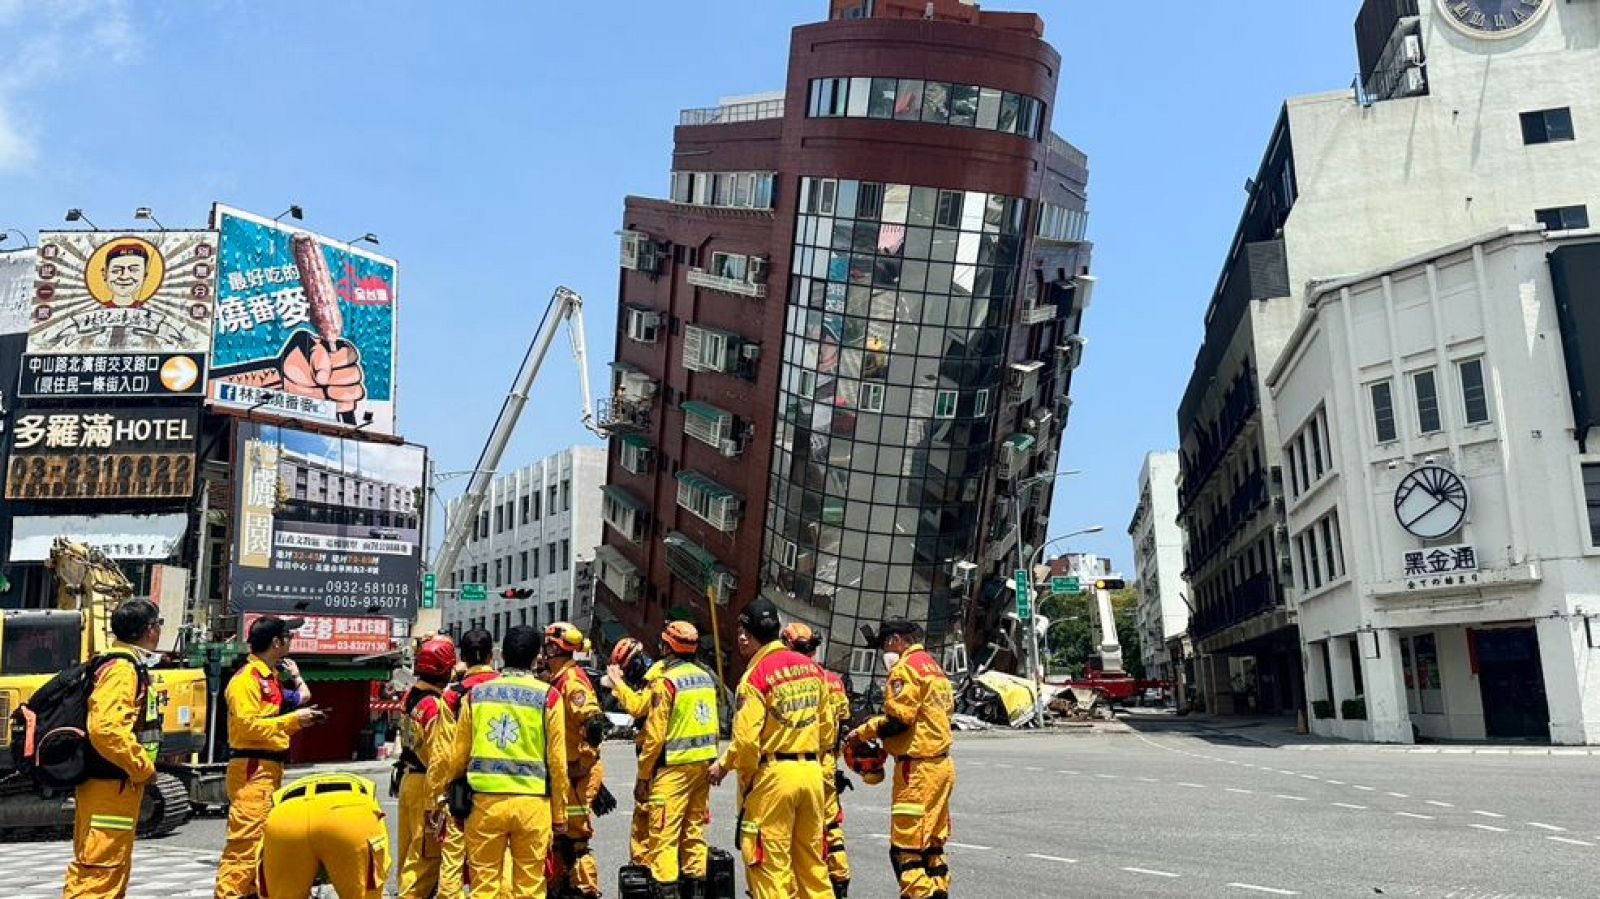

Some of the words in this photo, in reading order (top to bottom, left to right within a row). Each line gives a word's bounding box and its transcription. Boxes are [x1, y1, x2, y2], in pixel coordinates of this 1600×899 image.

[228, 265, 300, 291] 最好吃的
[29, 356, 160, 373] 中山路北濱街交叉路口
[14, 414, 114, 449] 多羅滿
[116, 419, 193, 441] HOTEL
[1404, 547, 1476, 575] 黑金通
[326, 580, 409, 595] 0932-581018
